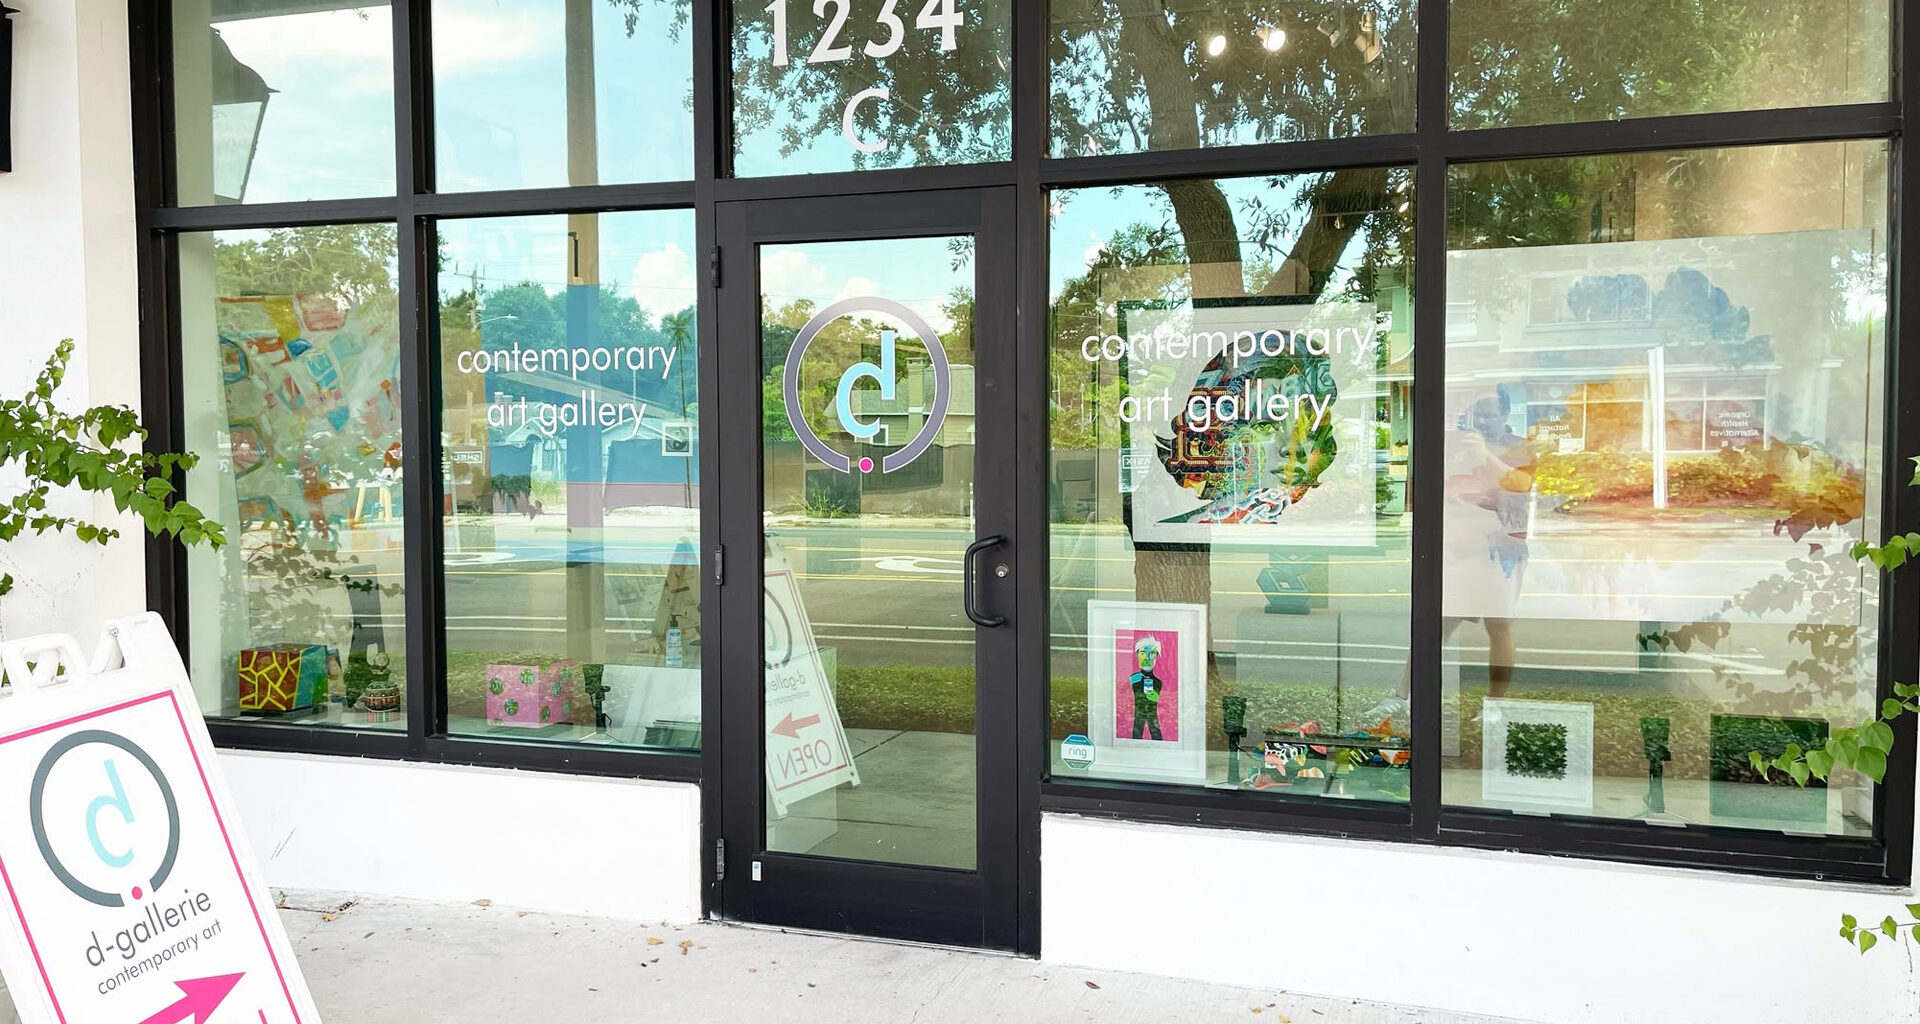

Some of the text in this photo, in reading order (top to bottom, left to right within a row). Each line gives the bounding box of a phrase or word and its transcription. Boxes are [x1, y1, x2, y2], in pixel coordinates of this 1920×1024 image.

[764, 0, 964, 66] 1234
[843, 87, 890, 152] C
[457, 342, 677, 381] contemporary
[1081, 326, 1376, 369] contemporary
[487, 389, 647, 435] art gallery
[1118, 378, 1332, 432] art gallery
[1068, 748, 1087, 760] ring
[86, 888, 212, 967] d-gallerie
[98, 919, 223, 995] contemporary art
